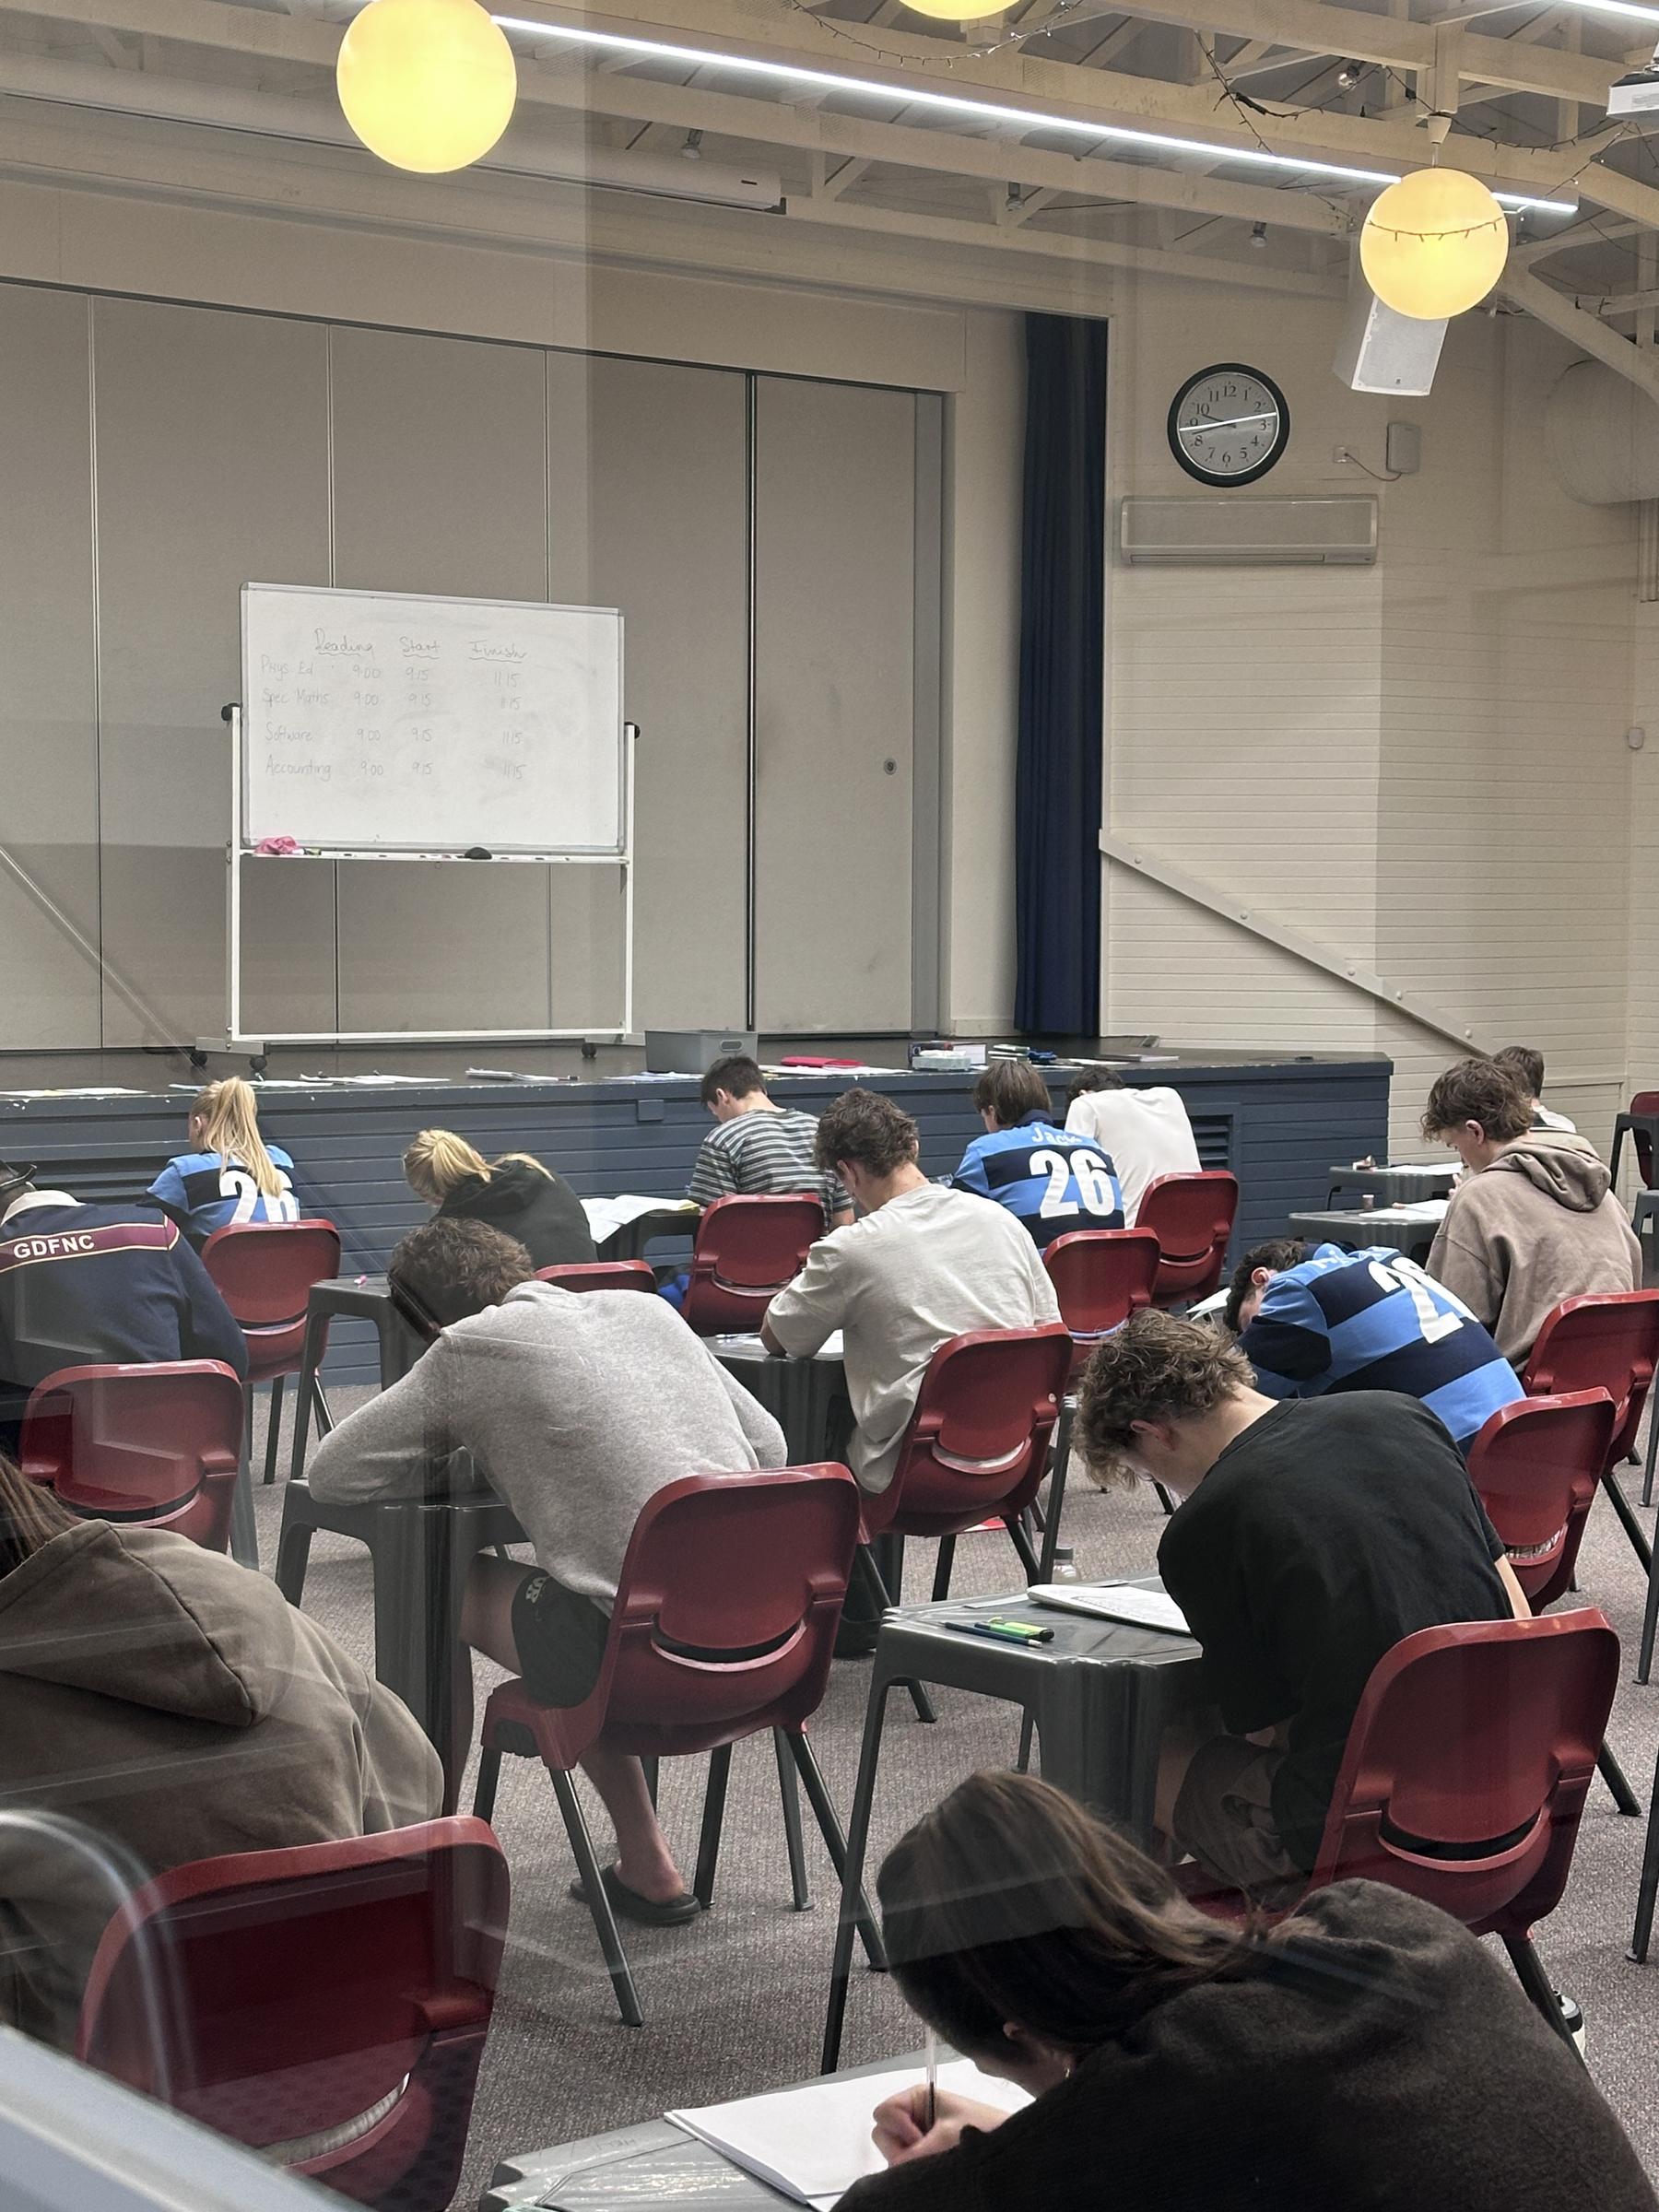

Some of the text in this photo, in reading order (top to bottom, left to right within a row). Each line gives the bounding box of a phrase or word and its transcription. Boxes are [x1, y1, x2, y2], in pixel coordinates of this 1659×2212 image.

[1209, 390, 1219, 402] 11
[1223, 385, 1237, 397] 12
[1243, 389, 1249, 401] 1
[1196, 403, 1210, 415] 10
[1253, 401, 1262, 412] 2
[1190, 418, 1198, 427] 9
[1259, 418, 1267, 431] 3
[1194, 435, 1203, 447] 8
[1251, 435, 1258, 447] 4
[1208, 447, 1216, 459] 7
[1222, 451, 1231, 464] 6
[1240, 447, 1248, 459] 5
[399, 636, 441, 653] Start
[298, 662, 314, 675] Ed
[262, 688, 289, 707] Spec
[265, 754, 332, 782] Accounting
[1029, 1148, 1115, 1218] 26
[13, 1235, 95, 1259] GDFNC
